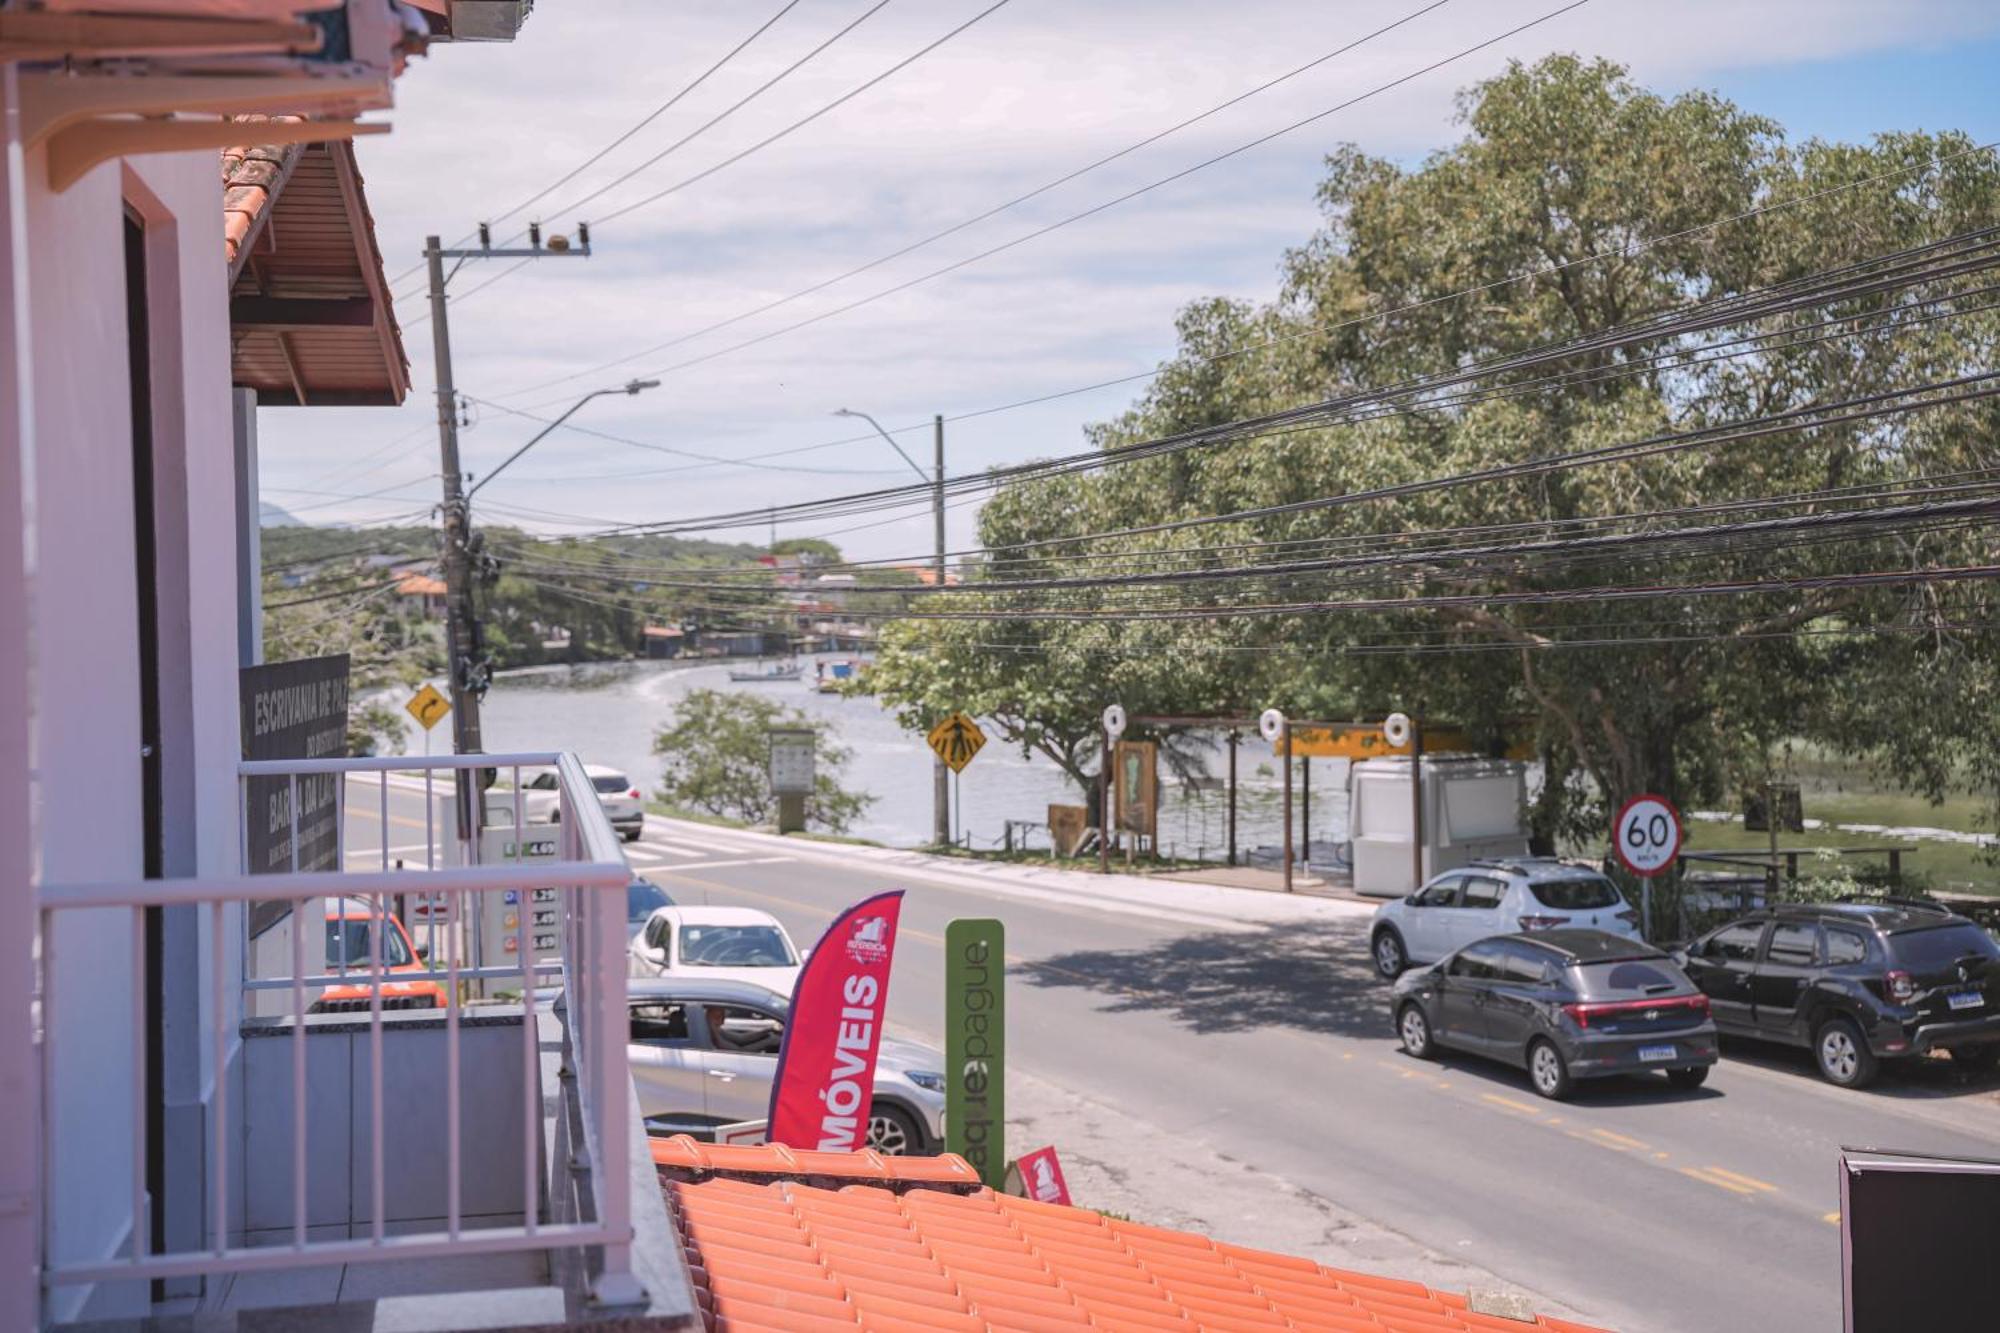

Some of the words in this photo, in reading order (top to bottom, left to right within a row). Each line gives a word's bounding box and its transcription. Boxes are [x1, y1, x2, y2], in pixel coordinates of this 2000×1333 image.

[255, 682, 318, 736] ESCRIVANIA
[320, 679, 331, 718] DE
[269, 781, 303, 834] BARA
[1627, 814, 1668, 847] 60
[817, 975, 879, 1153] MÓVEIS
